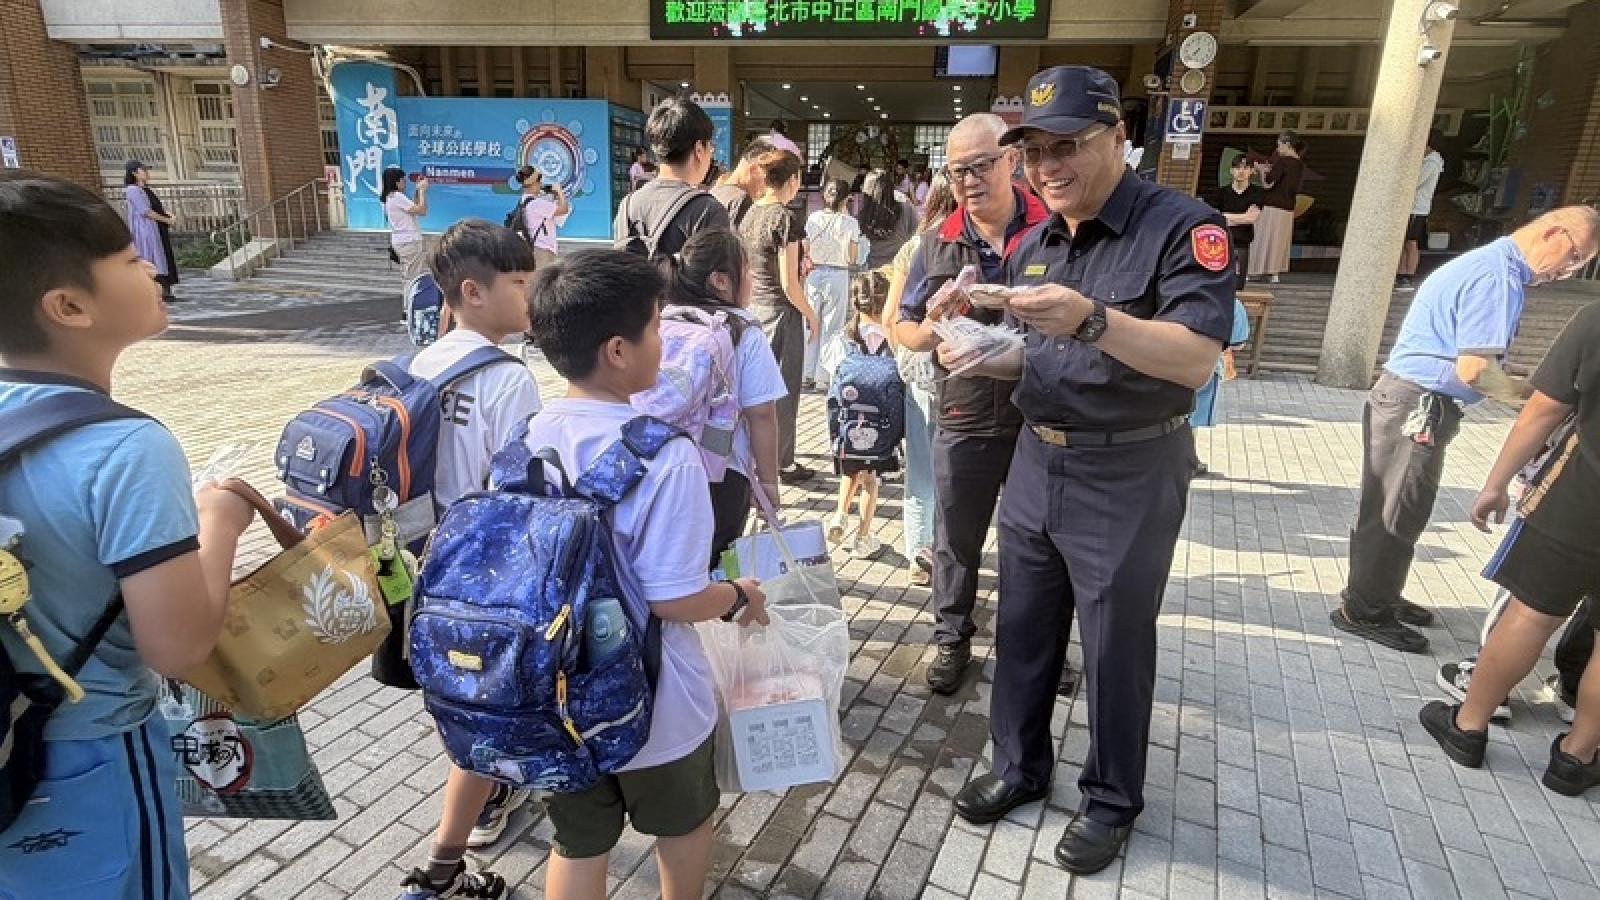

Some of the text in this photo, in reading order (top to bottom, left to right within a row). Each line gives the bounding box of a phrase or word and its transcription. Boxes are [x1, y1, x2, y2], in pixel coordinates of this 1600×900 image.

[345, 81, 399, 196] 南門
[418, 139, 502, 157] 全球公民學校
